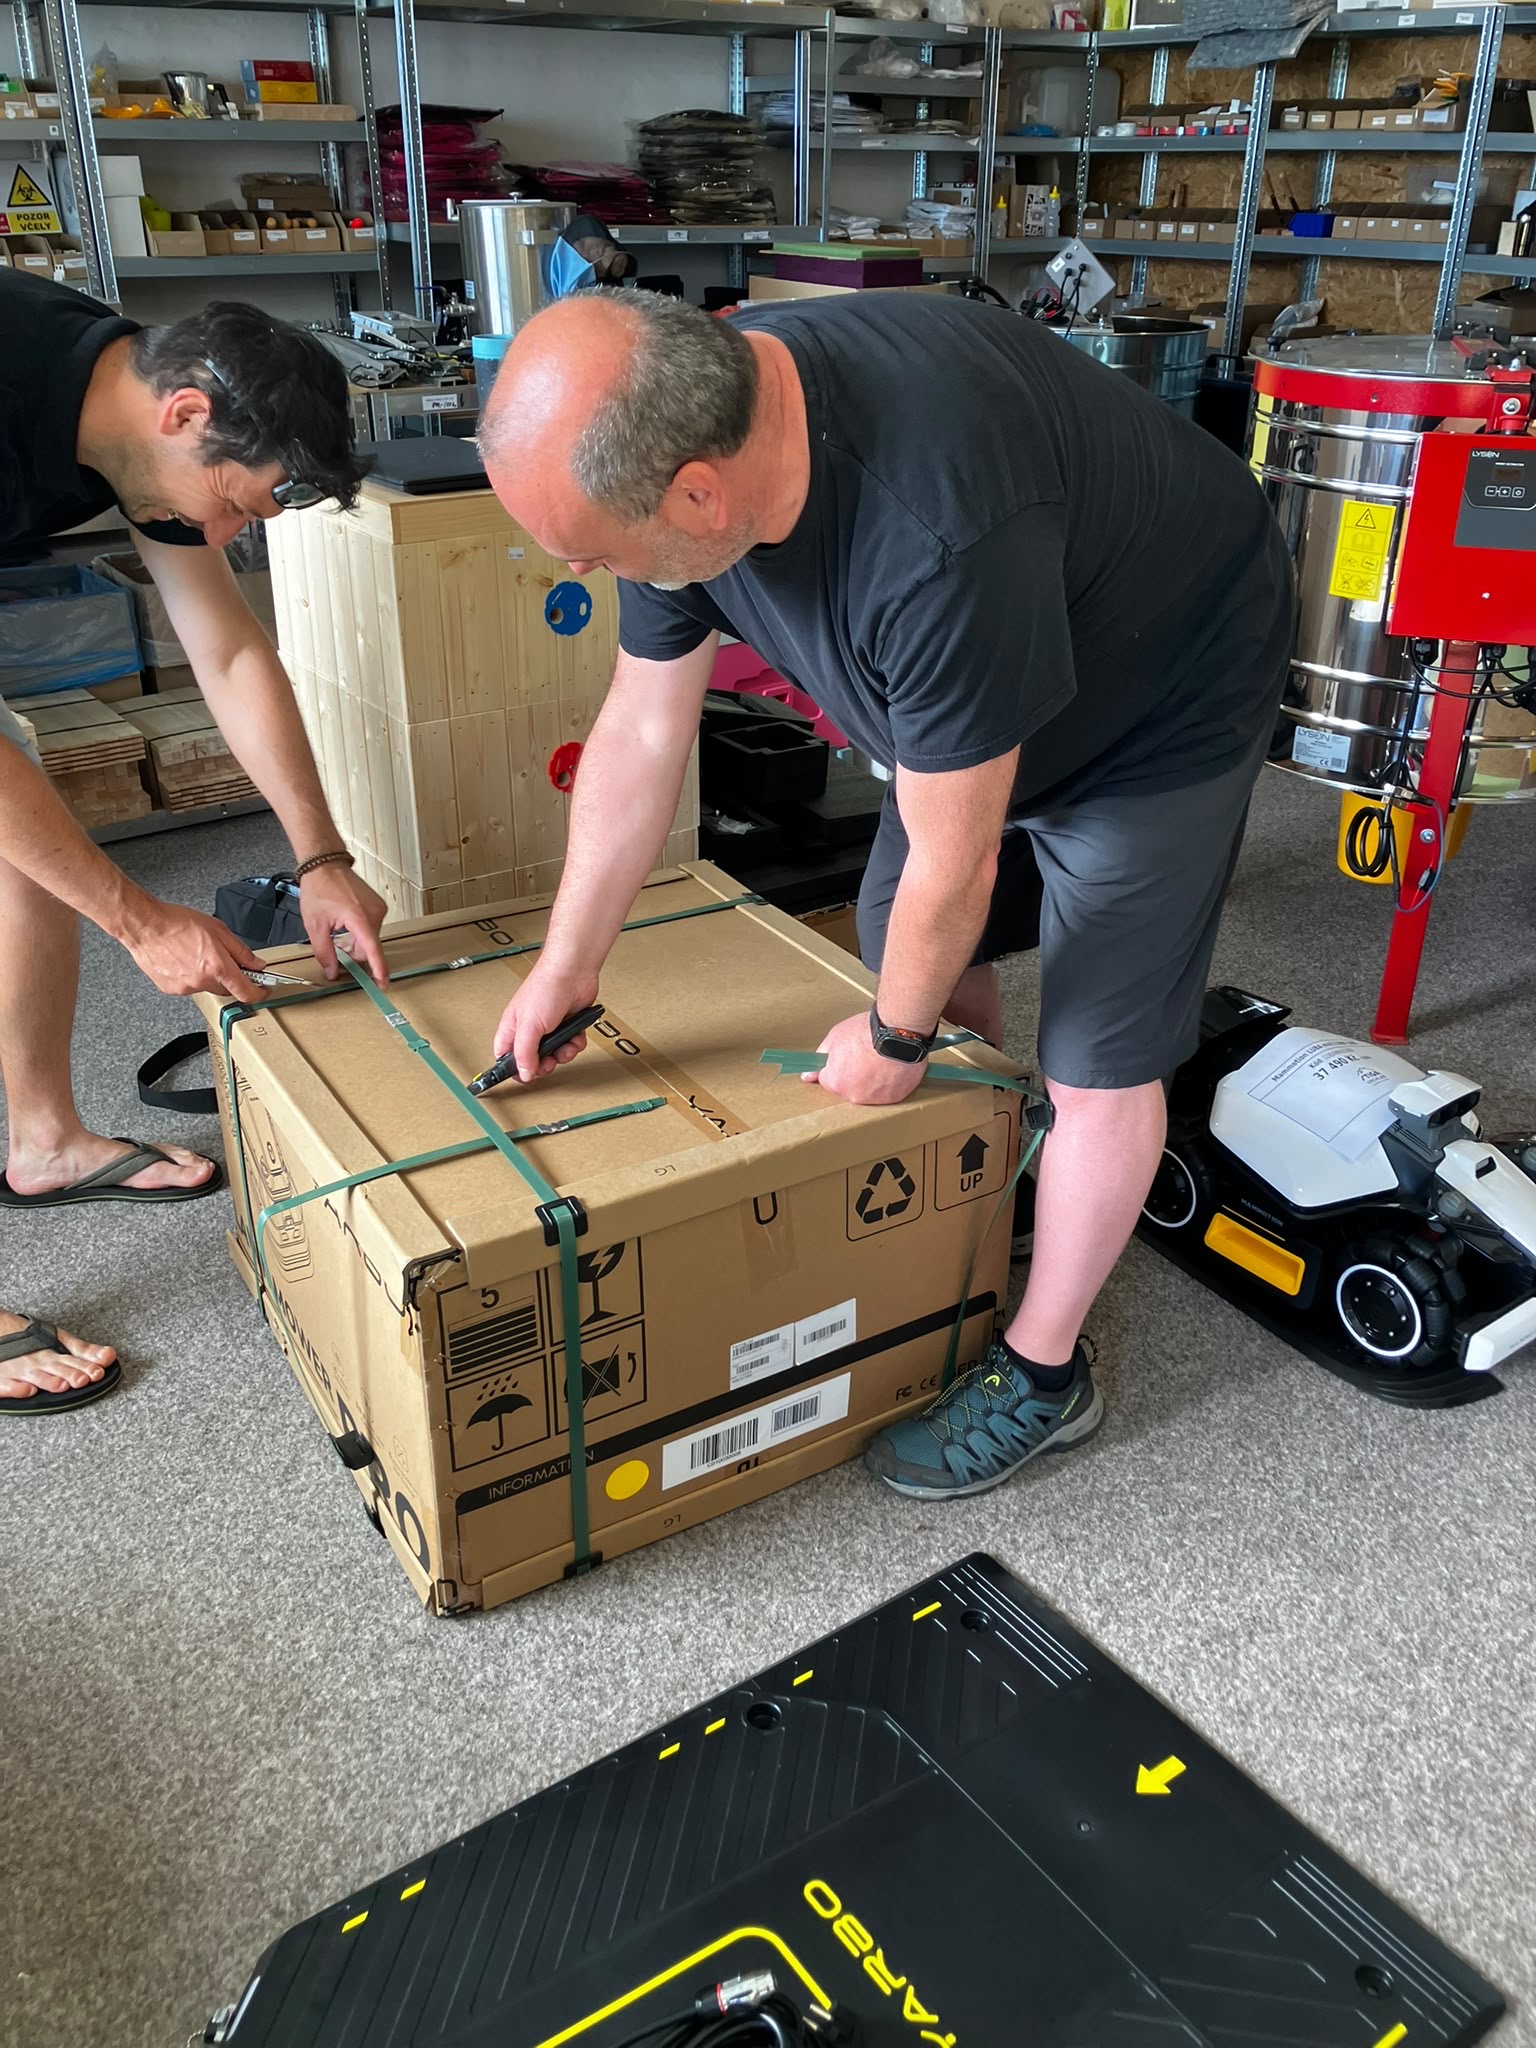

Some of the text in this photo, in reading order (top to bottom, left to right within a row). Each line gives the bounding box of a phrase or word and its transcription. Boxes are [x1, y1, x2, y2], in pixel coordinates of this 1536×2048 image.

[16, 212, 50, 221] POZOR
[20, 222, 51, 231] VČELY
[1312, 1067, 1329, 1081] 37
[1328, 1056, 1349, 1071] 490
[959, 1172, 984, 1193] UP
[481, 1287, 500, 1309] 5
[488, 1449, 595, 1500] INFORMATIN
